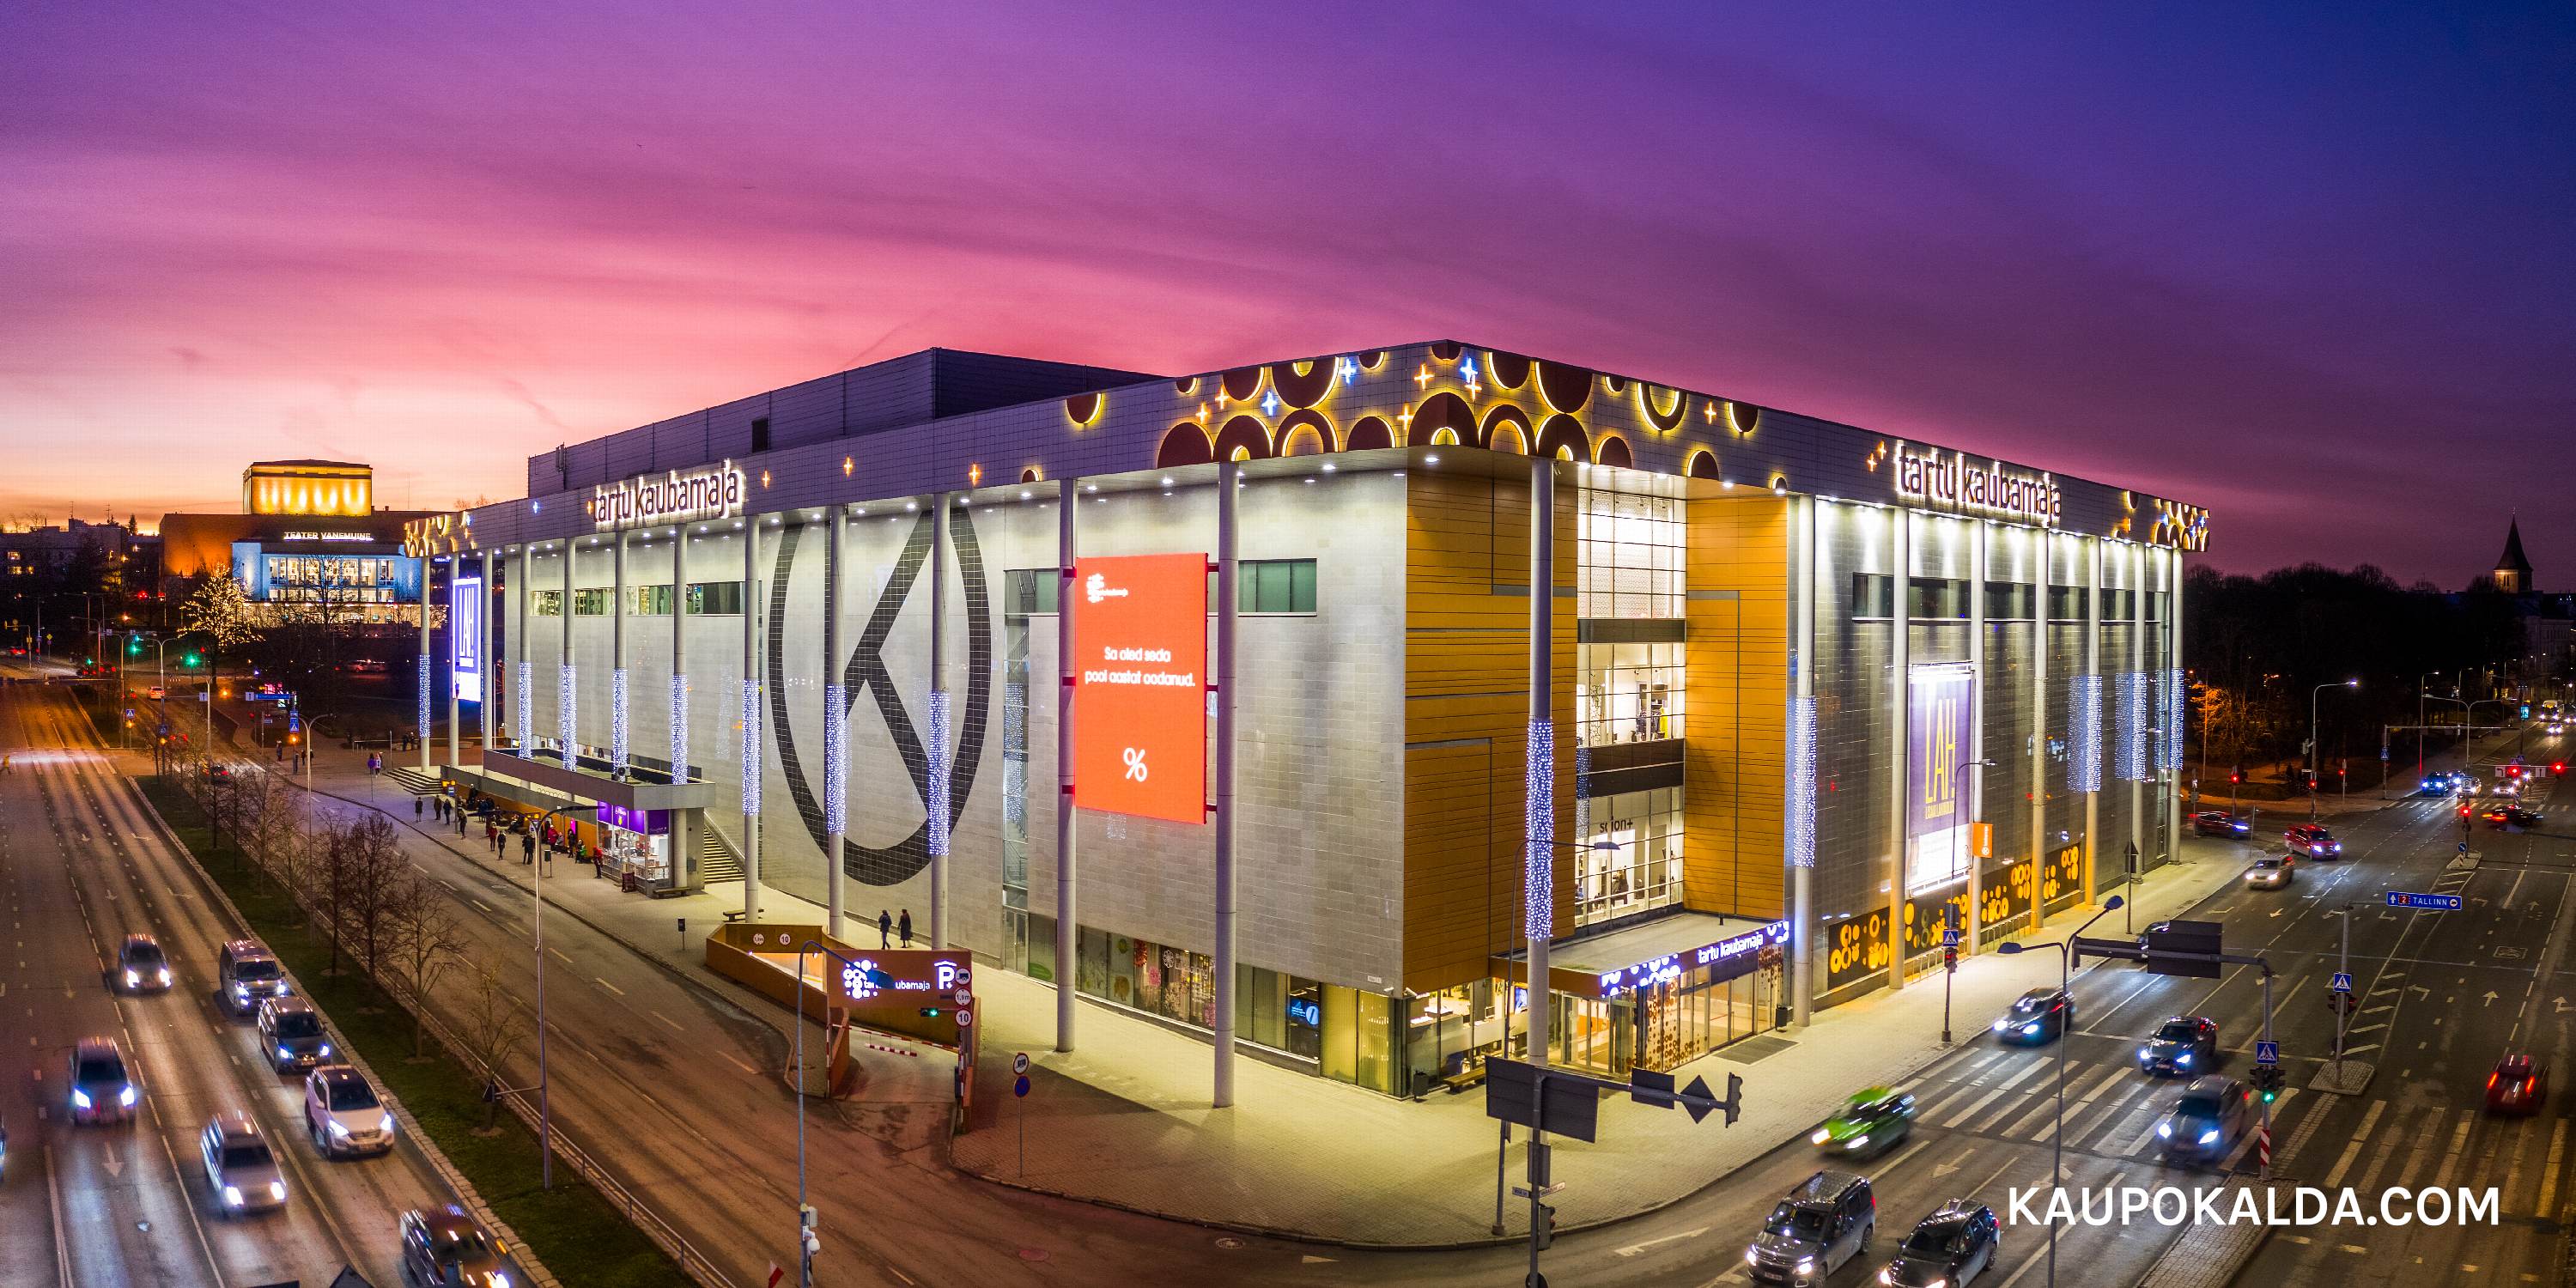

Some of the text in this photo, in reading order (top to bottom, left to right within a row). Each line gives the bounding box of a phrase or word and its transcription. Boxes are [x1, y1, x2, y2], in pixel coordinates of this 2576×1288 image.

[592, 461, 738, 523] tartu kaubamaja
[1899, 444, 2061, 527] tartu kaubamaja
[283, 532, 372, 541] TEATER VANEMUINE
[1104, 646, 1171, 663] Sa oled seda
[1084, 669, 1196, 687] pool aastat oodanud.
[1123, 746, 1148, 782] %
[2413, 896, 2447, 906] TALLINN
[781, 935, 789, 944] 10
[1698, 931, 1764, 963] tartu kaubamaja
[895, 980, 931, 991] ubamaja
[939, 967, 955, 989] P
[958, 1013, 969, 1023] 10
